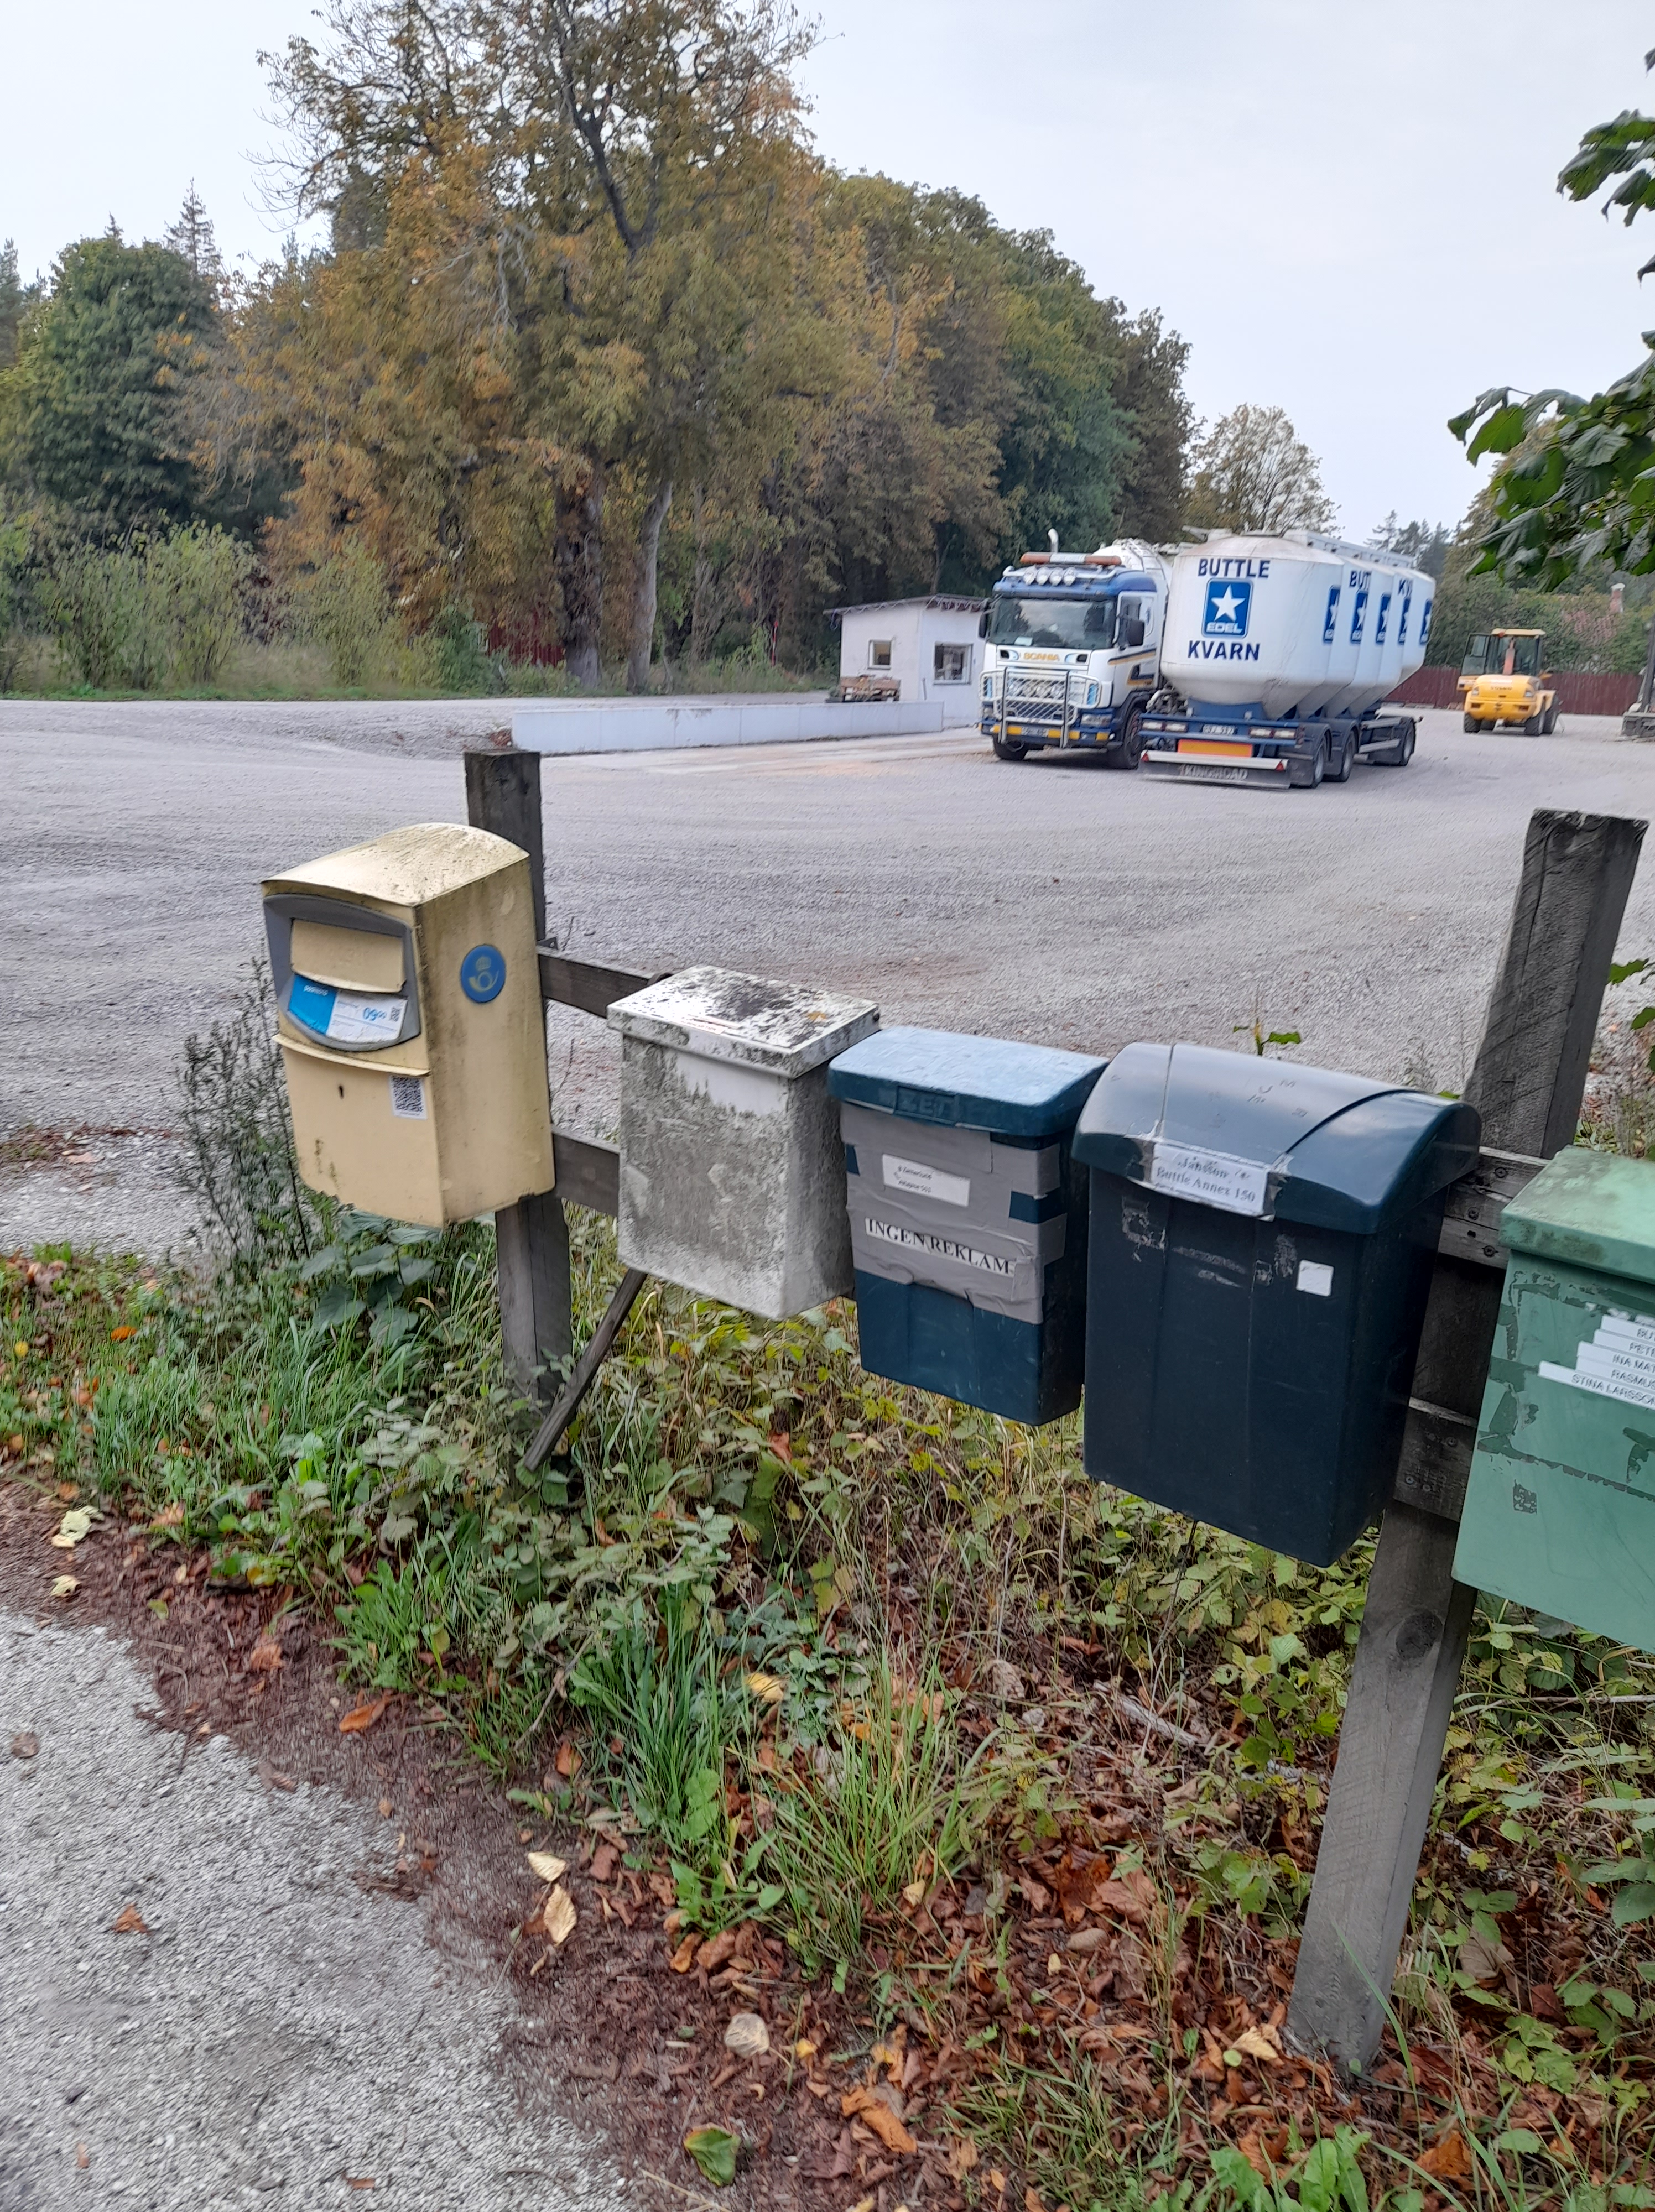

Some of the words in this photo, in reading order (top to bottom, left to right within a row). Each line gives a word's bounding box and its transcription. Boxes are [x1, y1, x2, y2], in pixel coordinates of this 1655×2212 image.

[1198, 557, 1271, 578] BUTTLE
[1206, 622, 1243, 634] EDEL
[1023, 652, 1060, 661] SCANIA
[1188, 640, 1260, 661] KVARN
[868, 1219, 925, 1248] INGEN
[930, 1236, 1009, 1274] REKLAM
[1637, 1328, 1655, 1341] BU
[1572, 1374, 1604, 1391] STINA
